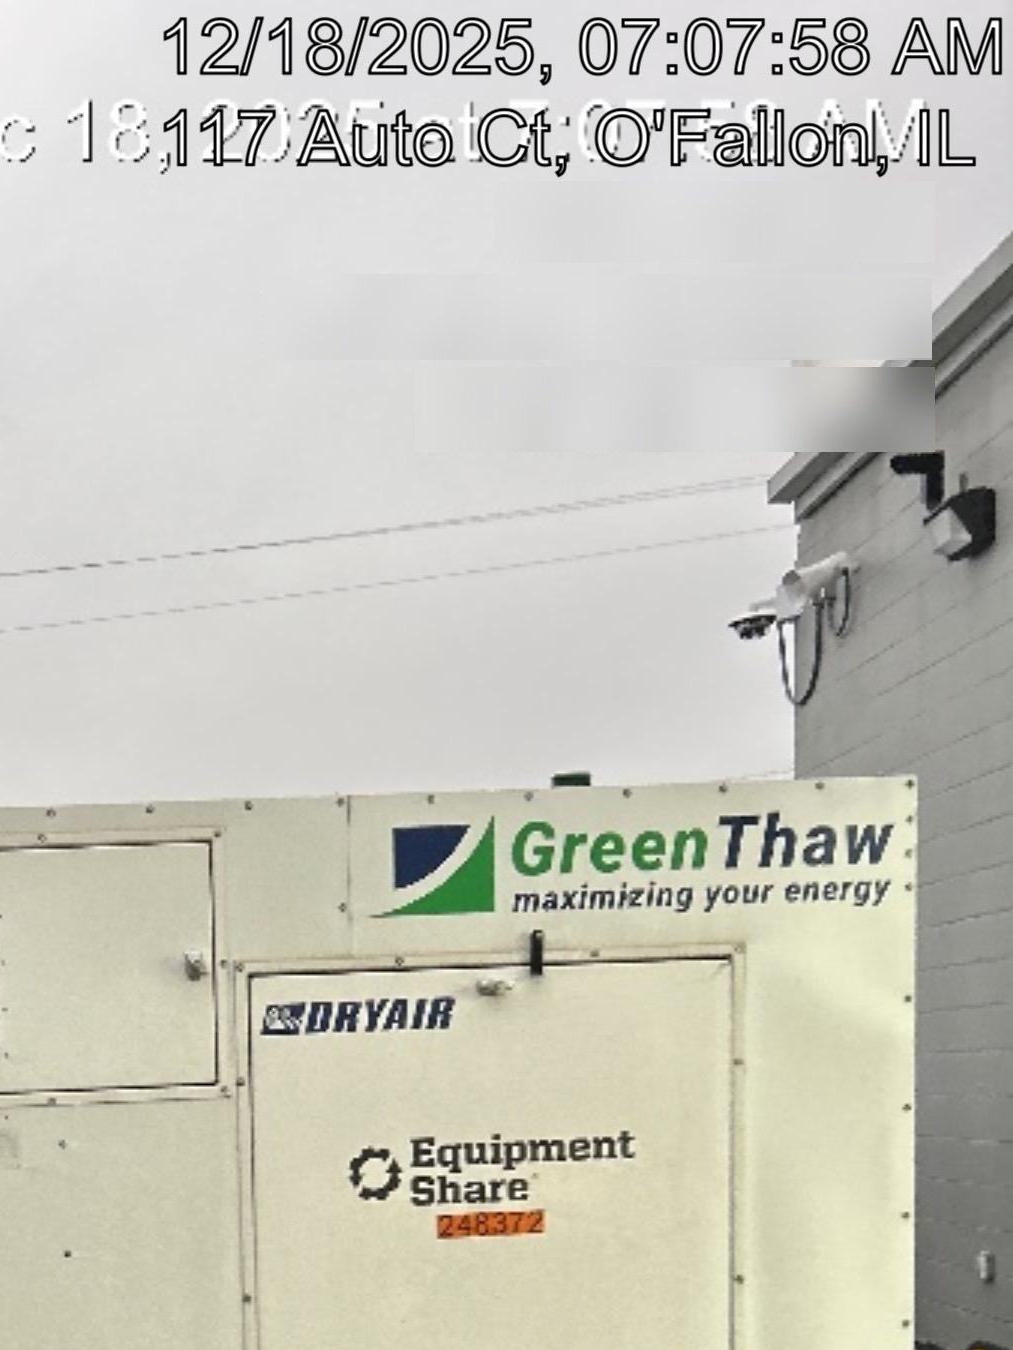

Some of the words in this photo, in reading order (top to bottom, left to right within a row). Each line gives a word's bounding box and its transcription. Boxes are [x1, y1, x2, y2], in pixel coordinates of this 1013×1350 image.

[511, 811, 894, 876] GreenThaw
[511, 882, 694, 913] maximizing
[703, 883, 774, 912] your
[784, 879, 892, 906] energy
[305, 995, 456, 1034] DRYAIR
[410, 1130, 637, 1173] Equipment
[410, 1175, 529, 1206] Share
[438, 1211, 544, 1238] 248372
